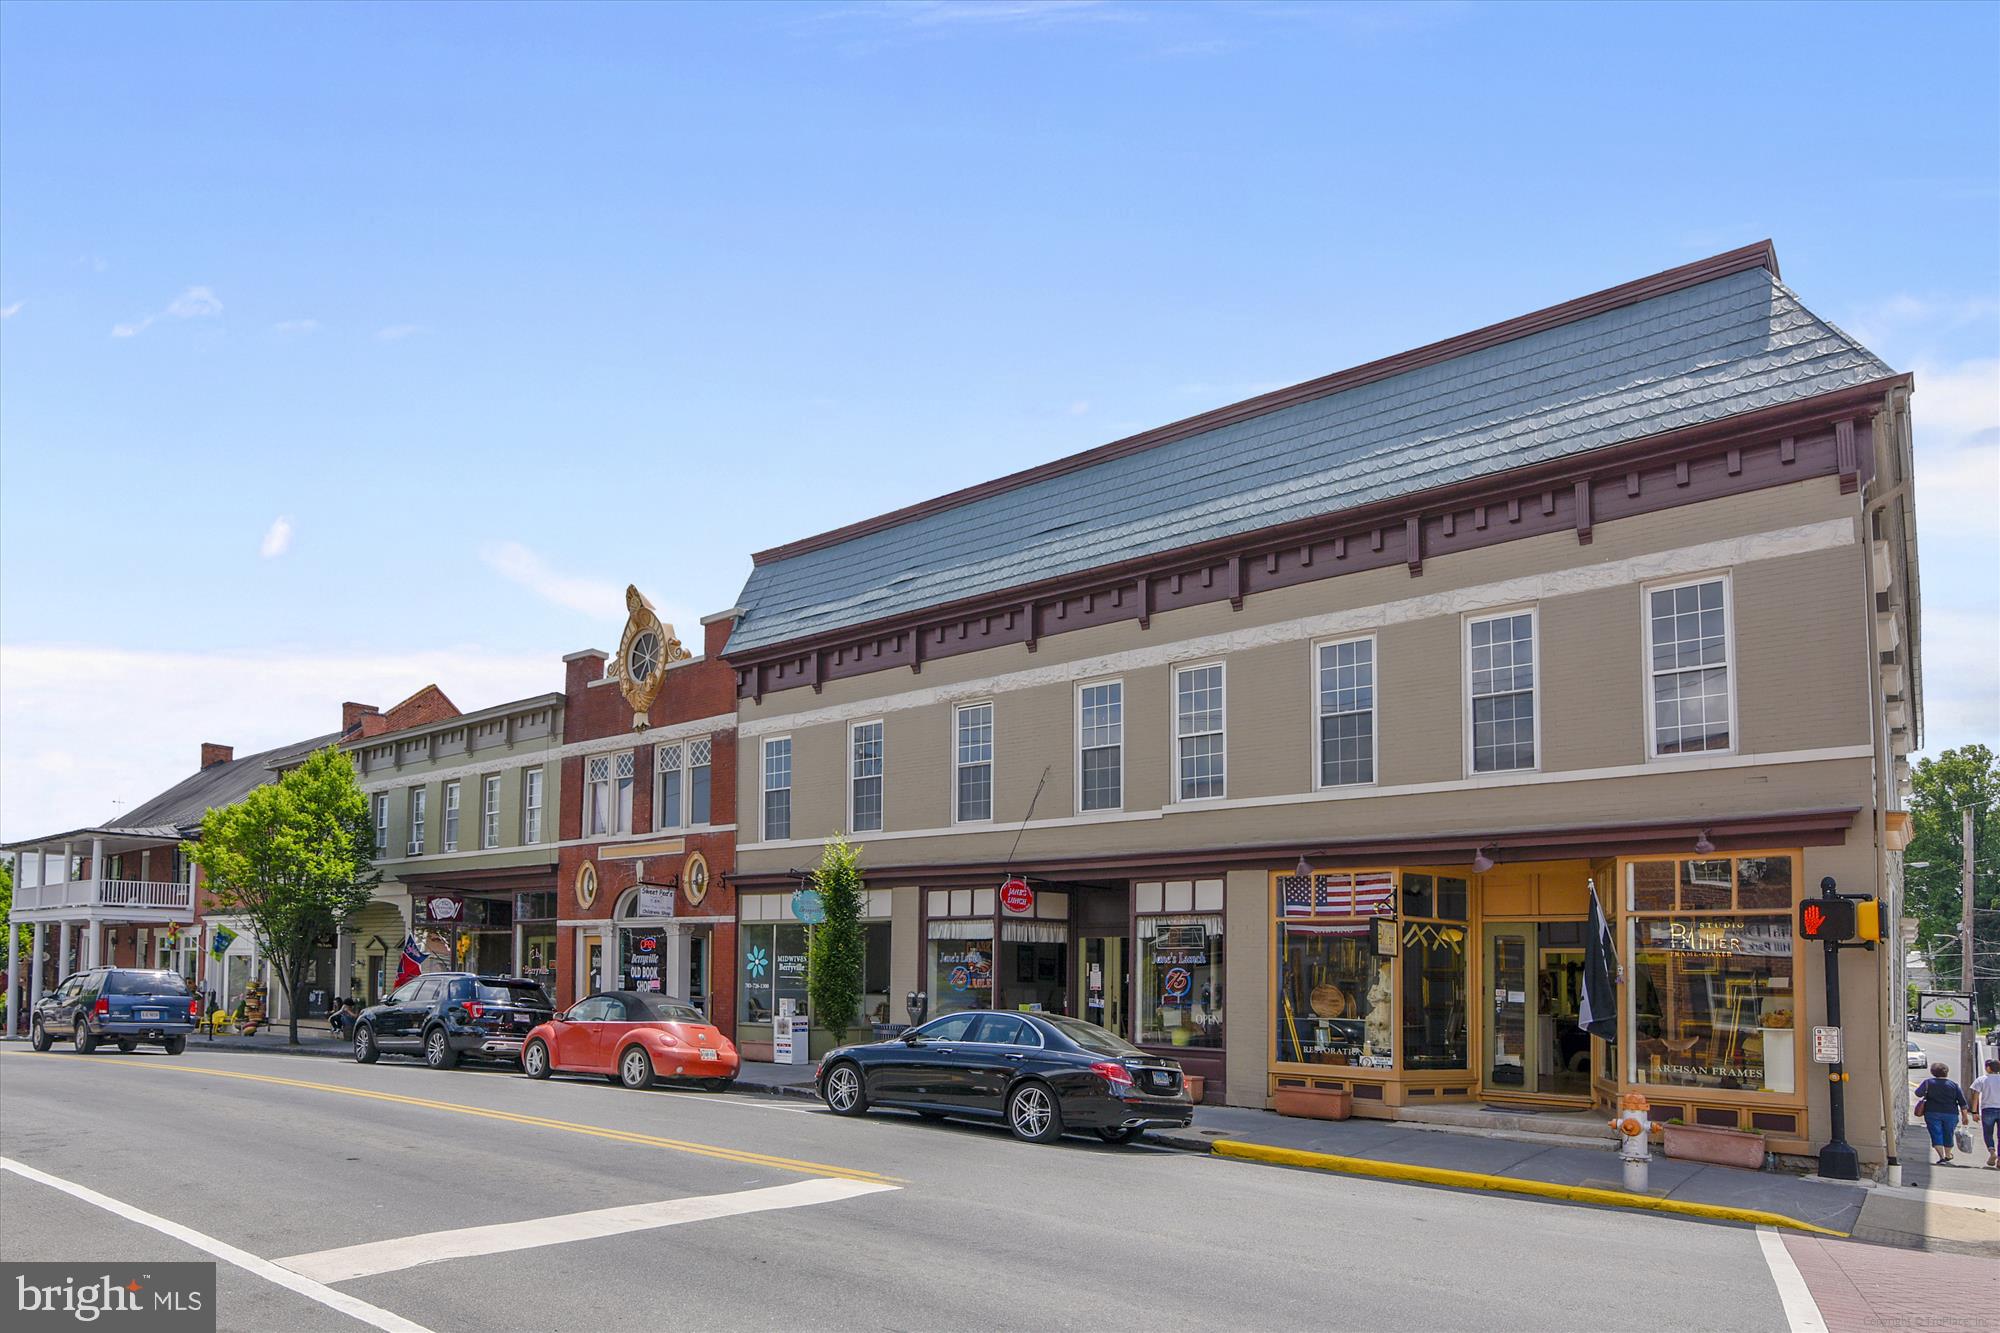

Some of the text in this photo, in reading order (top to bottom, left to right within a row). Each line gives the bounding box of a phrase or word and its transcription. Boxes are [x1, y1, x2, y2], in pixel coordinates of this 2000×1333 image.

[640, 939, 656, 949] OPEN
[631, 953, 659, 965] Berryville
[1152, 952, 1206, 964] Jane's Lunch
[631, 967, 658, 979] OLD BOOK
[779, 963, 805, 972] Berryville
[1195, 1014, 1220, 1025] OPEN
[1656, 1064, 1763, 1078] ARTISAN FRAMES
